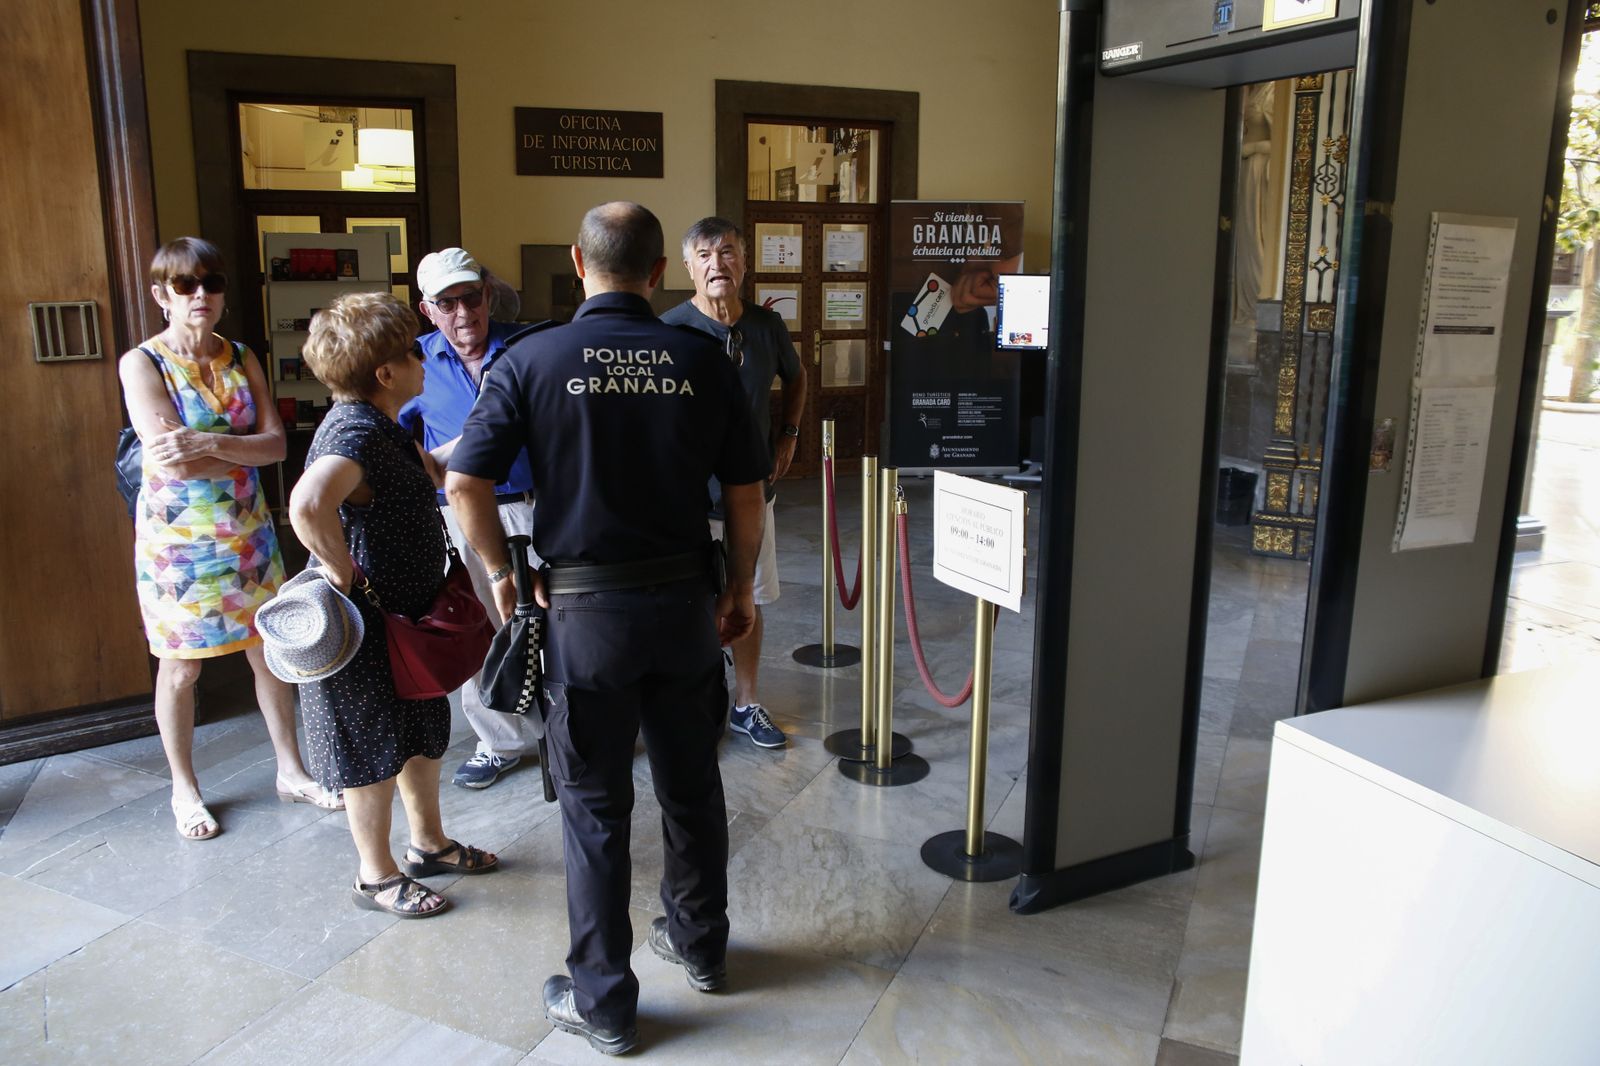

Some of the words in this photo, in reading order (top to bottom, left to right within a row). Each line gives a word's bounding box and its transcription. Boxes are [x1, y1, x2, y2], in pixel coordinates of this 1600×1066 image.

[1102, 44, 1139, 60] RANGER
[560, 114, 621, 131] OFICINA
[523, 134, 545, 149] DE
[552, 135, 657, 152] INFORMACION
[551, 155, 632, 171] TURISTICA
[933, 211, 945, 223] Si
[945, 212, 975, 223] vienes
[913, 224, 1002, 244] GRANADA
[912, 244, 953, 256] échatela
[954, 246, 965, 256] al
[966, 245, 1002, 256] bolsillo
[583, 347, 675, 365] POLICIA
[606, 365, 655, 377] LOCAL
[566, 376, 695, 396] GRANADA
[950, 526, 969, 540] 09:00
[976, 534, 994, 549] 14:00
